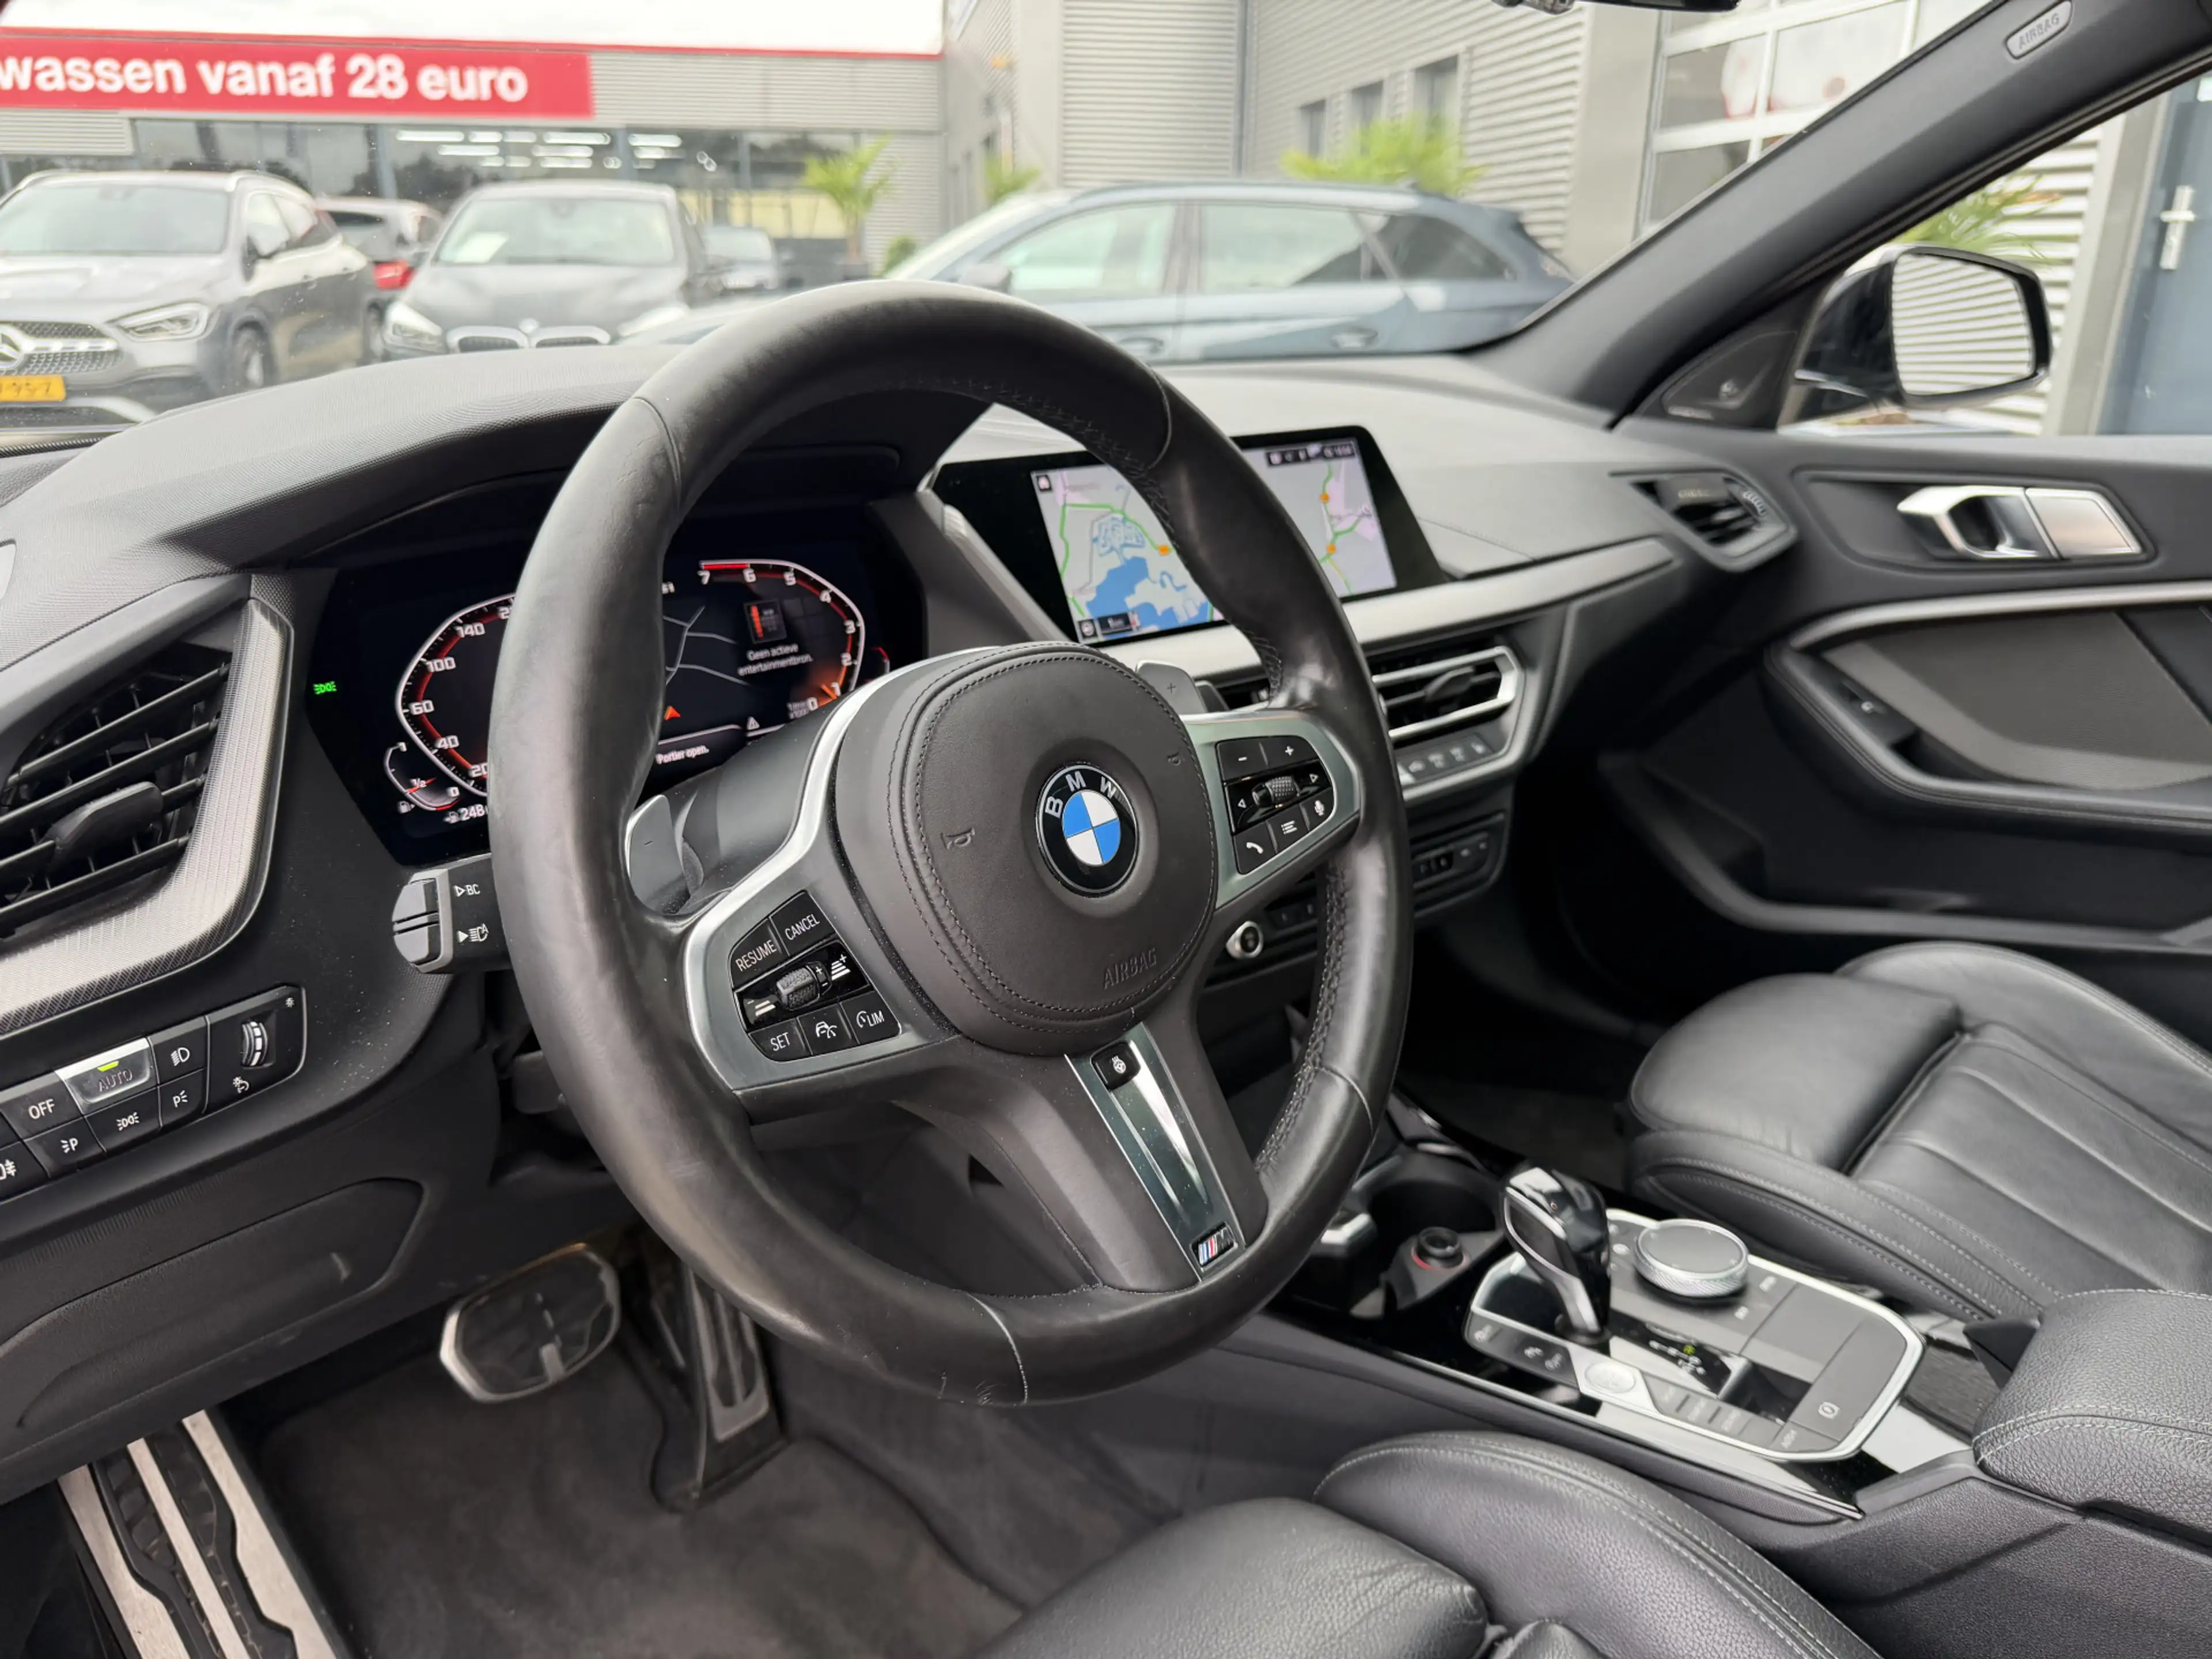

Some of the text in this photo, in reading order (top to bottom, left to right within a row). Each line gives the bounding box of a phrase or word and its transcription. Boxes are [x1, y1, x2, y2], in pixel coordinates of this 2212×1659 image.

[2018, 13, 2059, 50] AIRBAG
[0, 53, 528, 103] wassen vanaf 28 euro
[698, 570, 710, 585] 7
[743, 567, 756, 582] 6
[783, 570, 796, 586] 5
[820, 590, 831, 603] 4
[455, 622, 486, 638] 140
[844, 620, 855, 634] 3
[426, 657, 456, 672] 100
[841, 653, 852, 666] 2
[409, 699, 434, 715] 60
[435, 735, 459, 749] 40
[656, 745, 709, 765] Portier open.
[1045, 771, 1118, 819] BMW
[465, 884, 480, 895] BC
[785, 914, 820, 941] CANCEL
[735, 940, 777, 972] RESUME
[1103, 949, 1157, 990] AIRBAG
[866, 1010, 885, 1027] LIM
[770, 1032, 790, 1051] SET
[98, 1070, 132, 1091] AUTO
[28, 1098, 55, 1119] OFF
